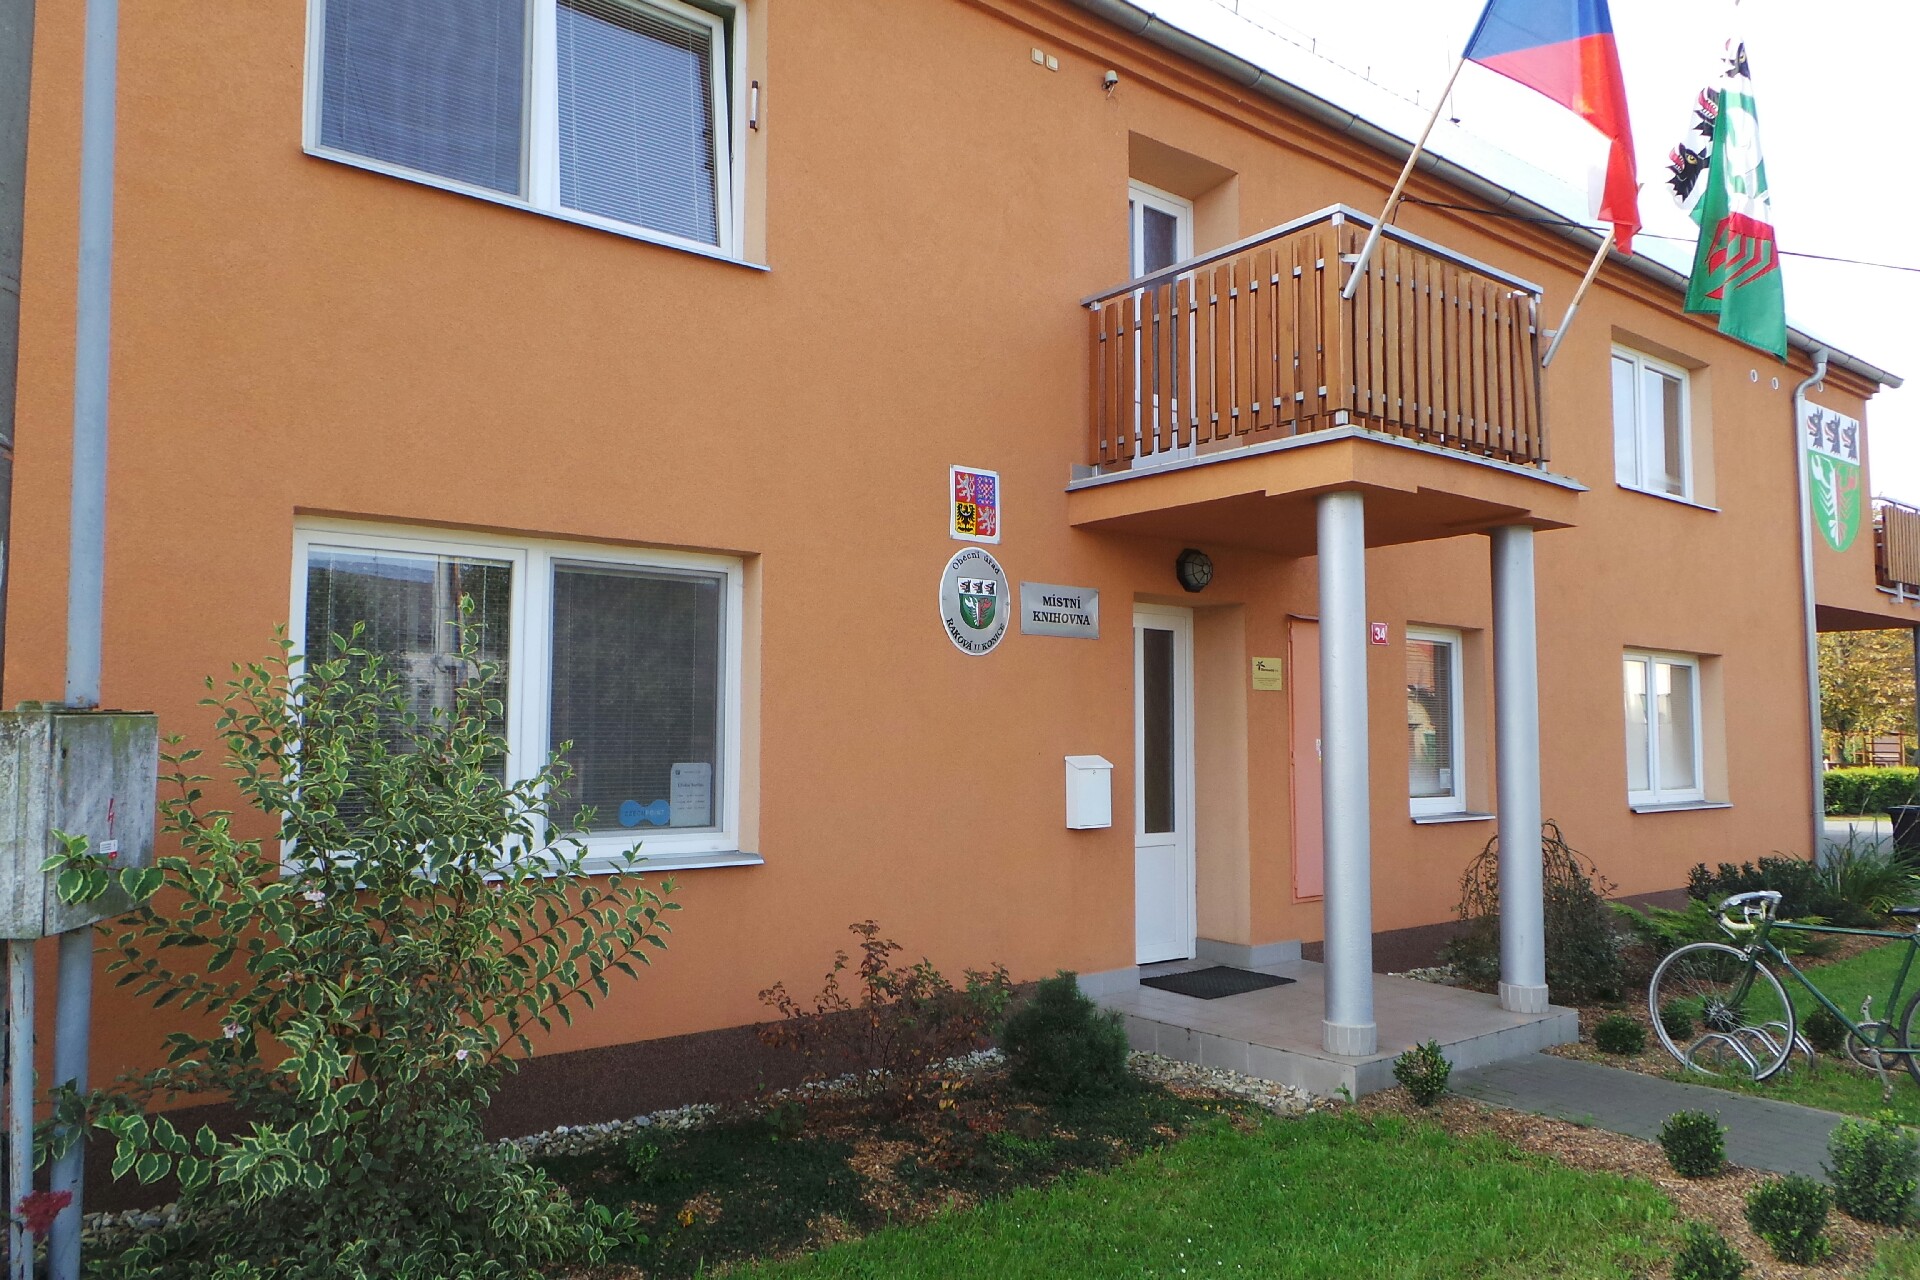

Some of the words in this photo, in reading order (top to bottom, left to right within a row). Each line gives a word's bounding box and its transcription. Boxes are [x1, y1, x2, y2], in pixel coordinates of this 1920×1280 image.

[952, 551, 980, 570] Obecní
[983, 555, 1001, 575] úřad
[1042, 593, 1081, 609] MÍSTNÍ
[1032, 610, 1091, 626] KNIHOVNA
[946, 617, 973, 651] RAKOVÁ
[981, 622, 1006, 651] KONICE
[1374, 627, 1386, 641] 34
